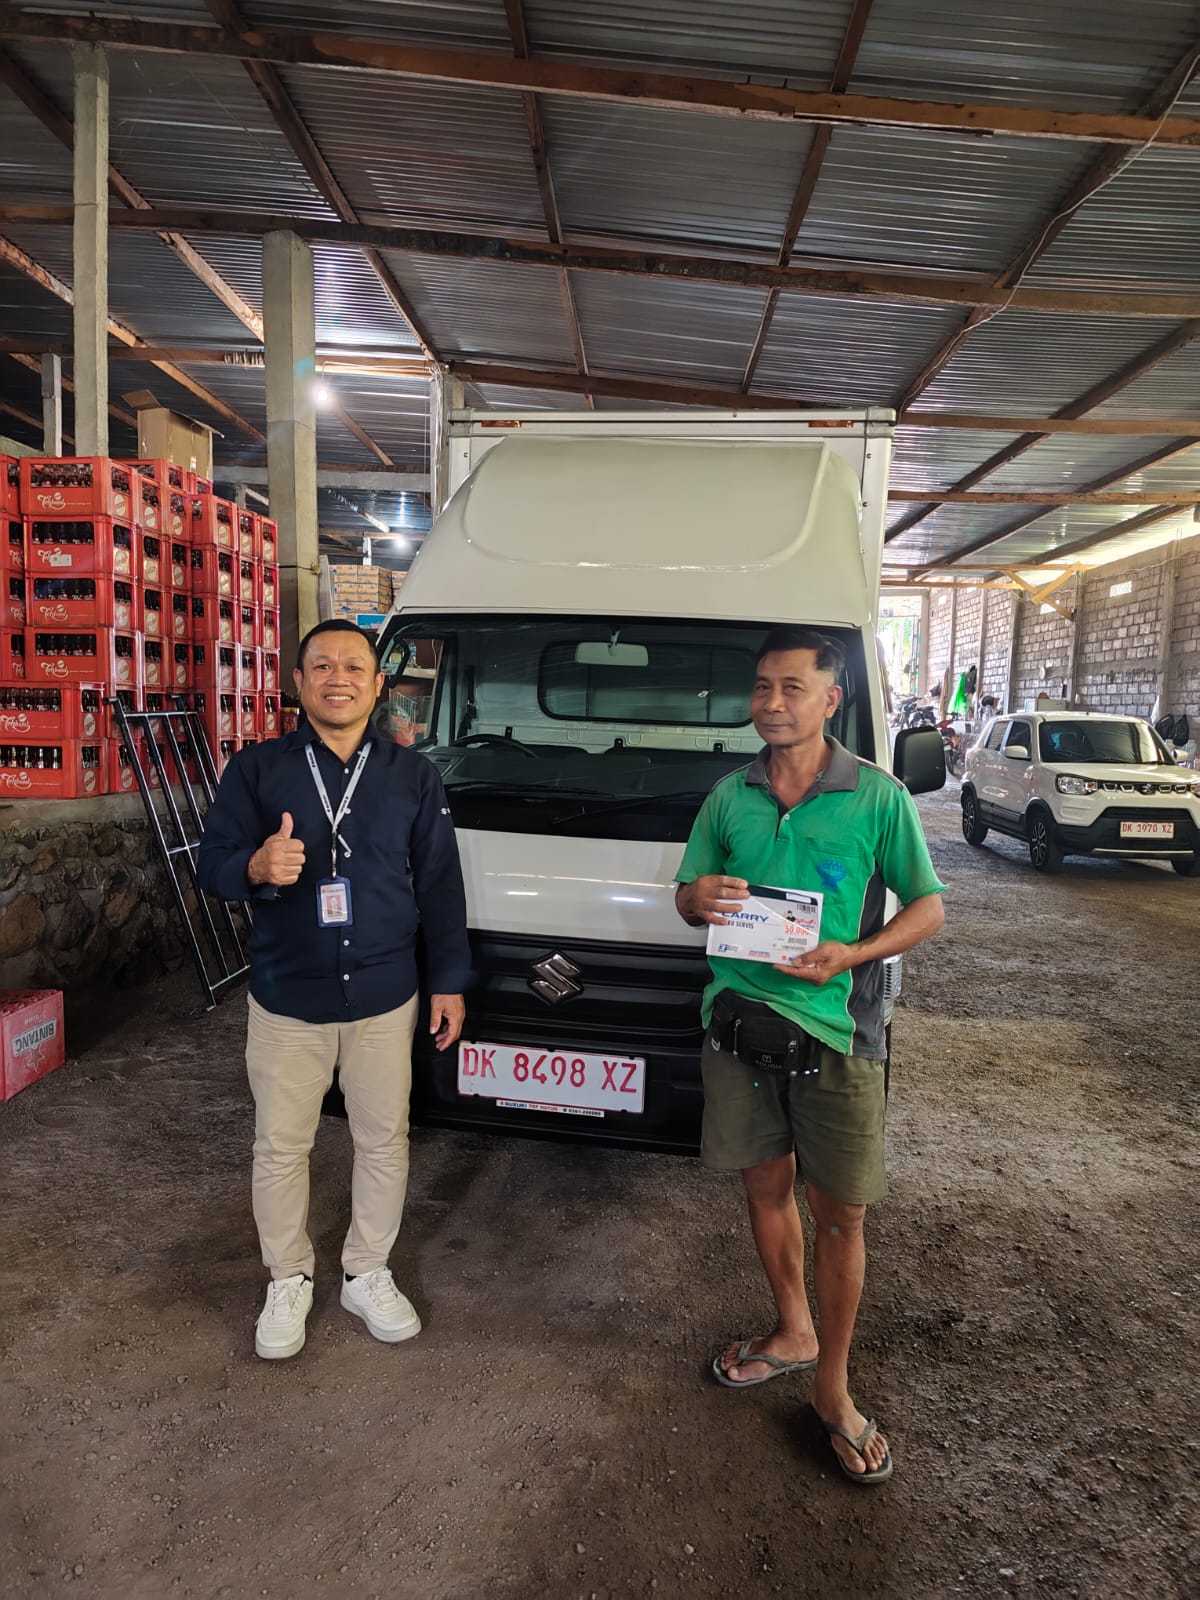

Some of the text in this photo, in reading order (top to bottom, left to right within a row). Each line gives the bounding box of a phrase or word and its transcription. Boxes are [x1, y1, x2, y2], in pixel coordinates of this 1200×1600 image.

[1122, 823, 1172, 833] DK 1970 XZ
[463, 1047, 637, 1094] DK 8498 XZ
